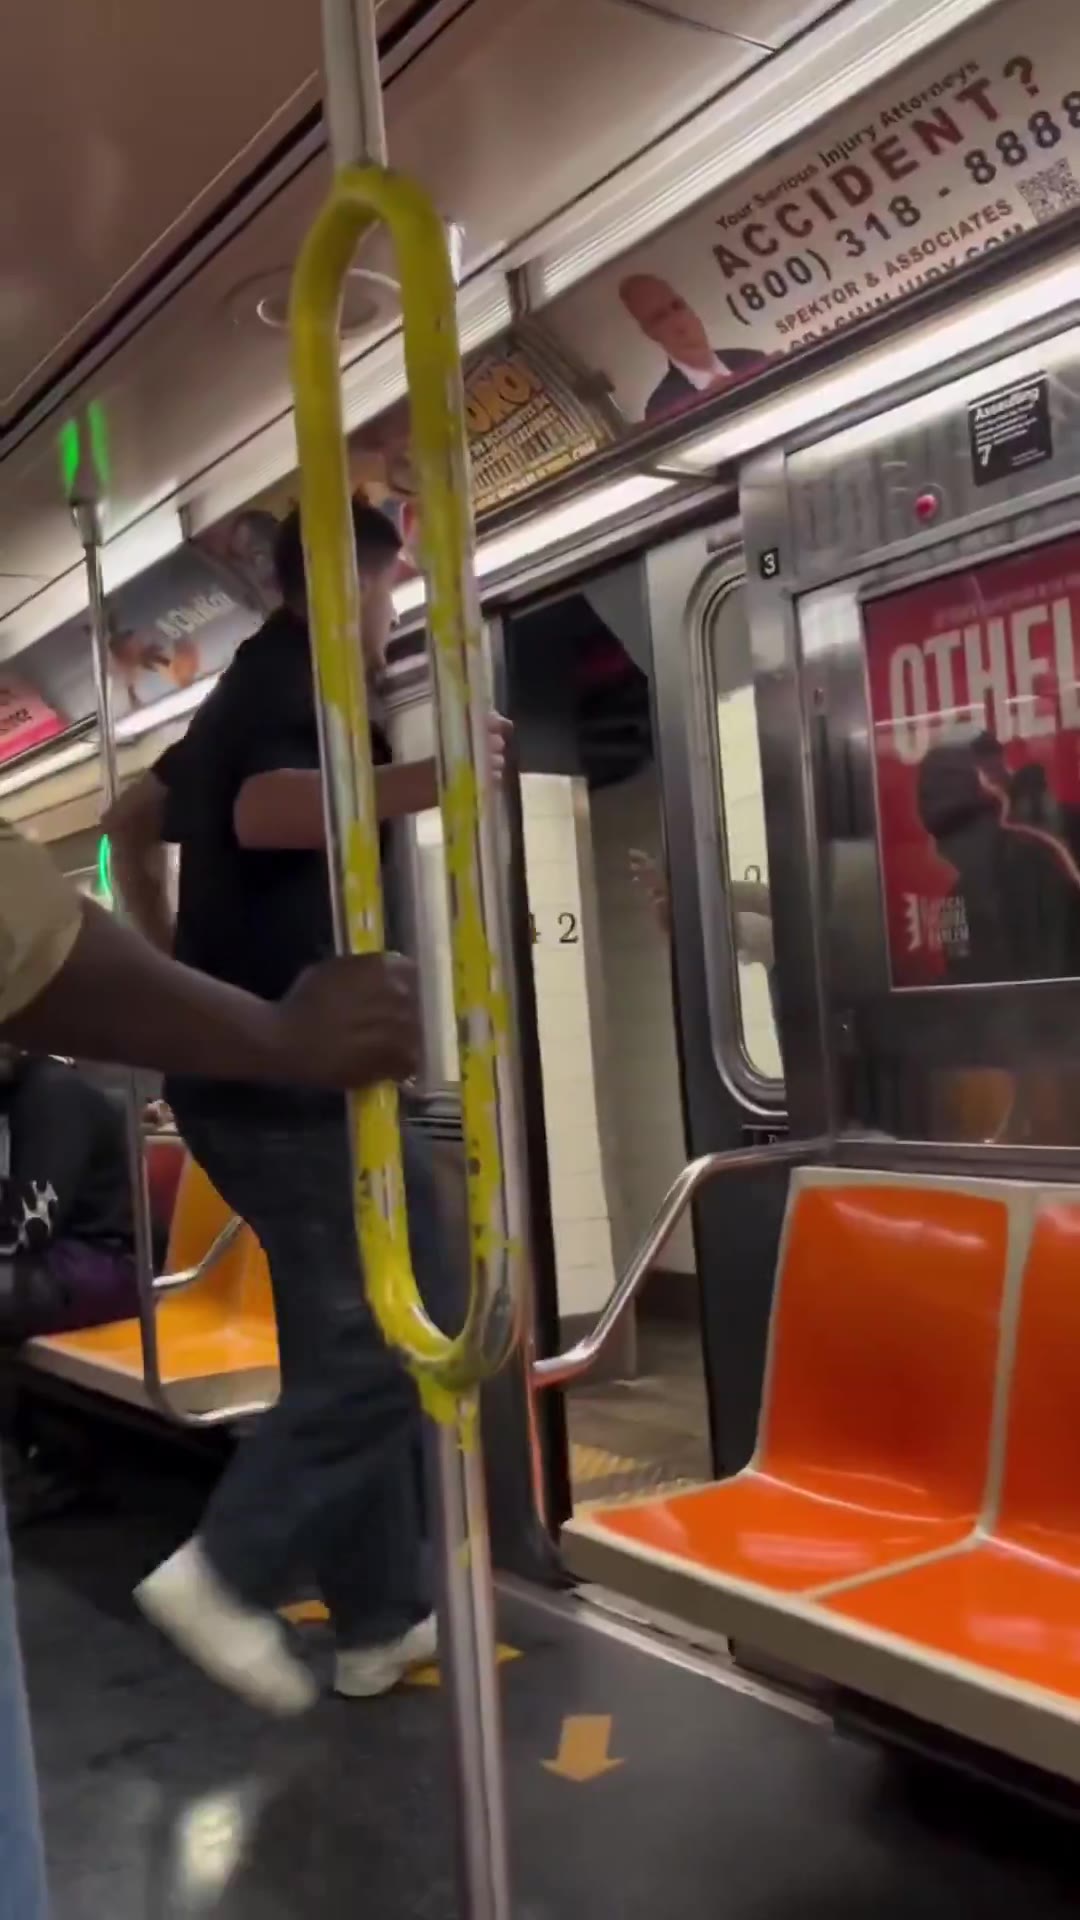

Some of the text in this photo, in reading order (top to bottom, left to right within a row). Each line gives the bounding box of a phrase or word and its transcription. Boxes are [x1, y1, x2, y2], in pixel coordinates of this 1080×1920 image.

[716, 61, 980, 230] Your Serious Injury Attorneys
[726, 248, 832, 326] (800)
[836, 195, 922, 258] 318
[775, 281, 861, 335] SPEKTOR
[864, 272, 880, 288] &
[884, 200, 1013, 279] ASSOCIATES
[978, 443, 992, 466] 7
[764, 552, 776, 575] 3
[890, 596, 1080, 766] OTHEL
